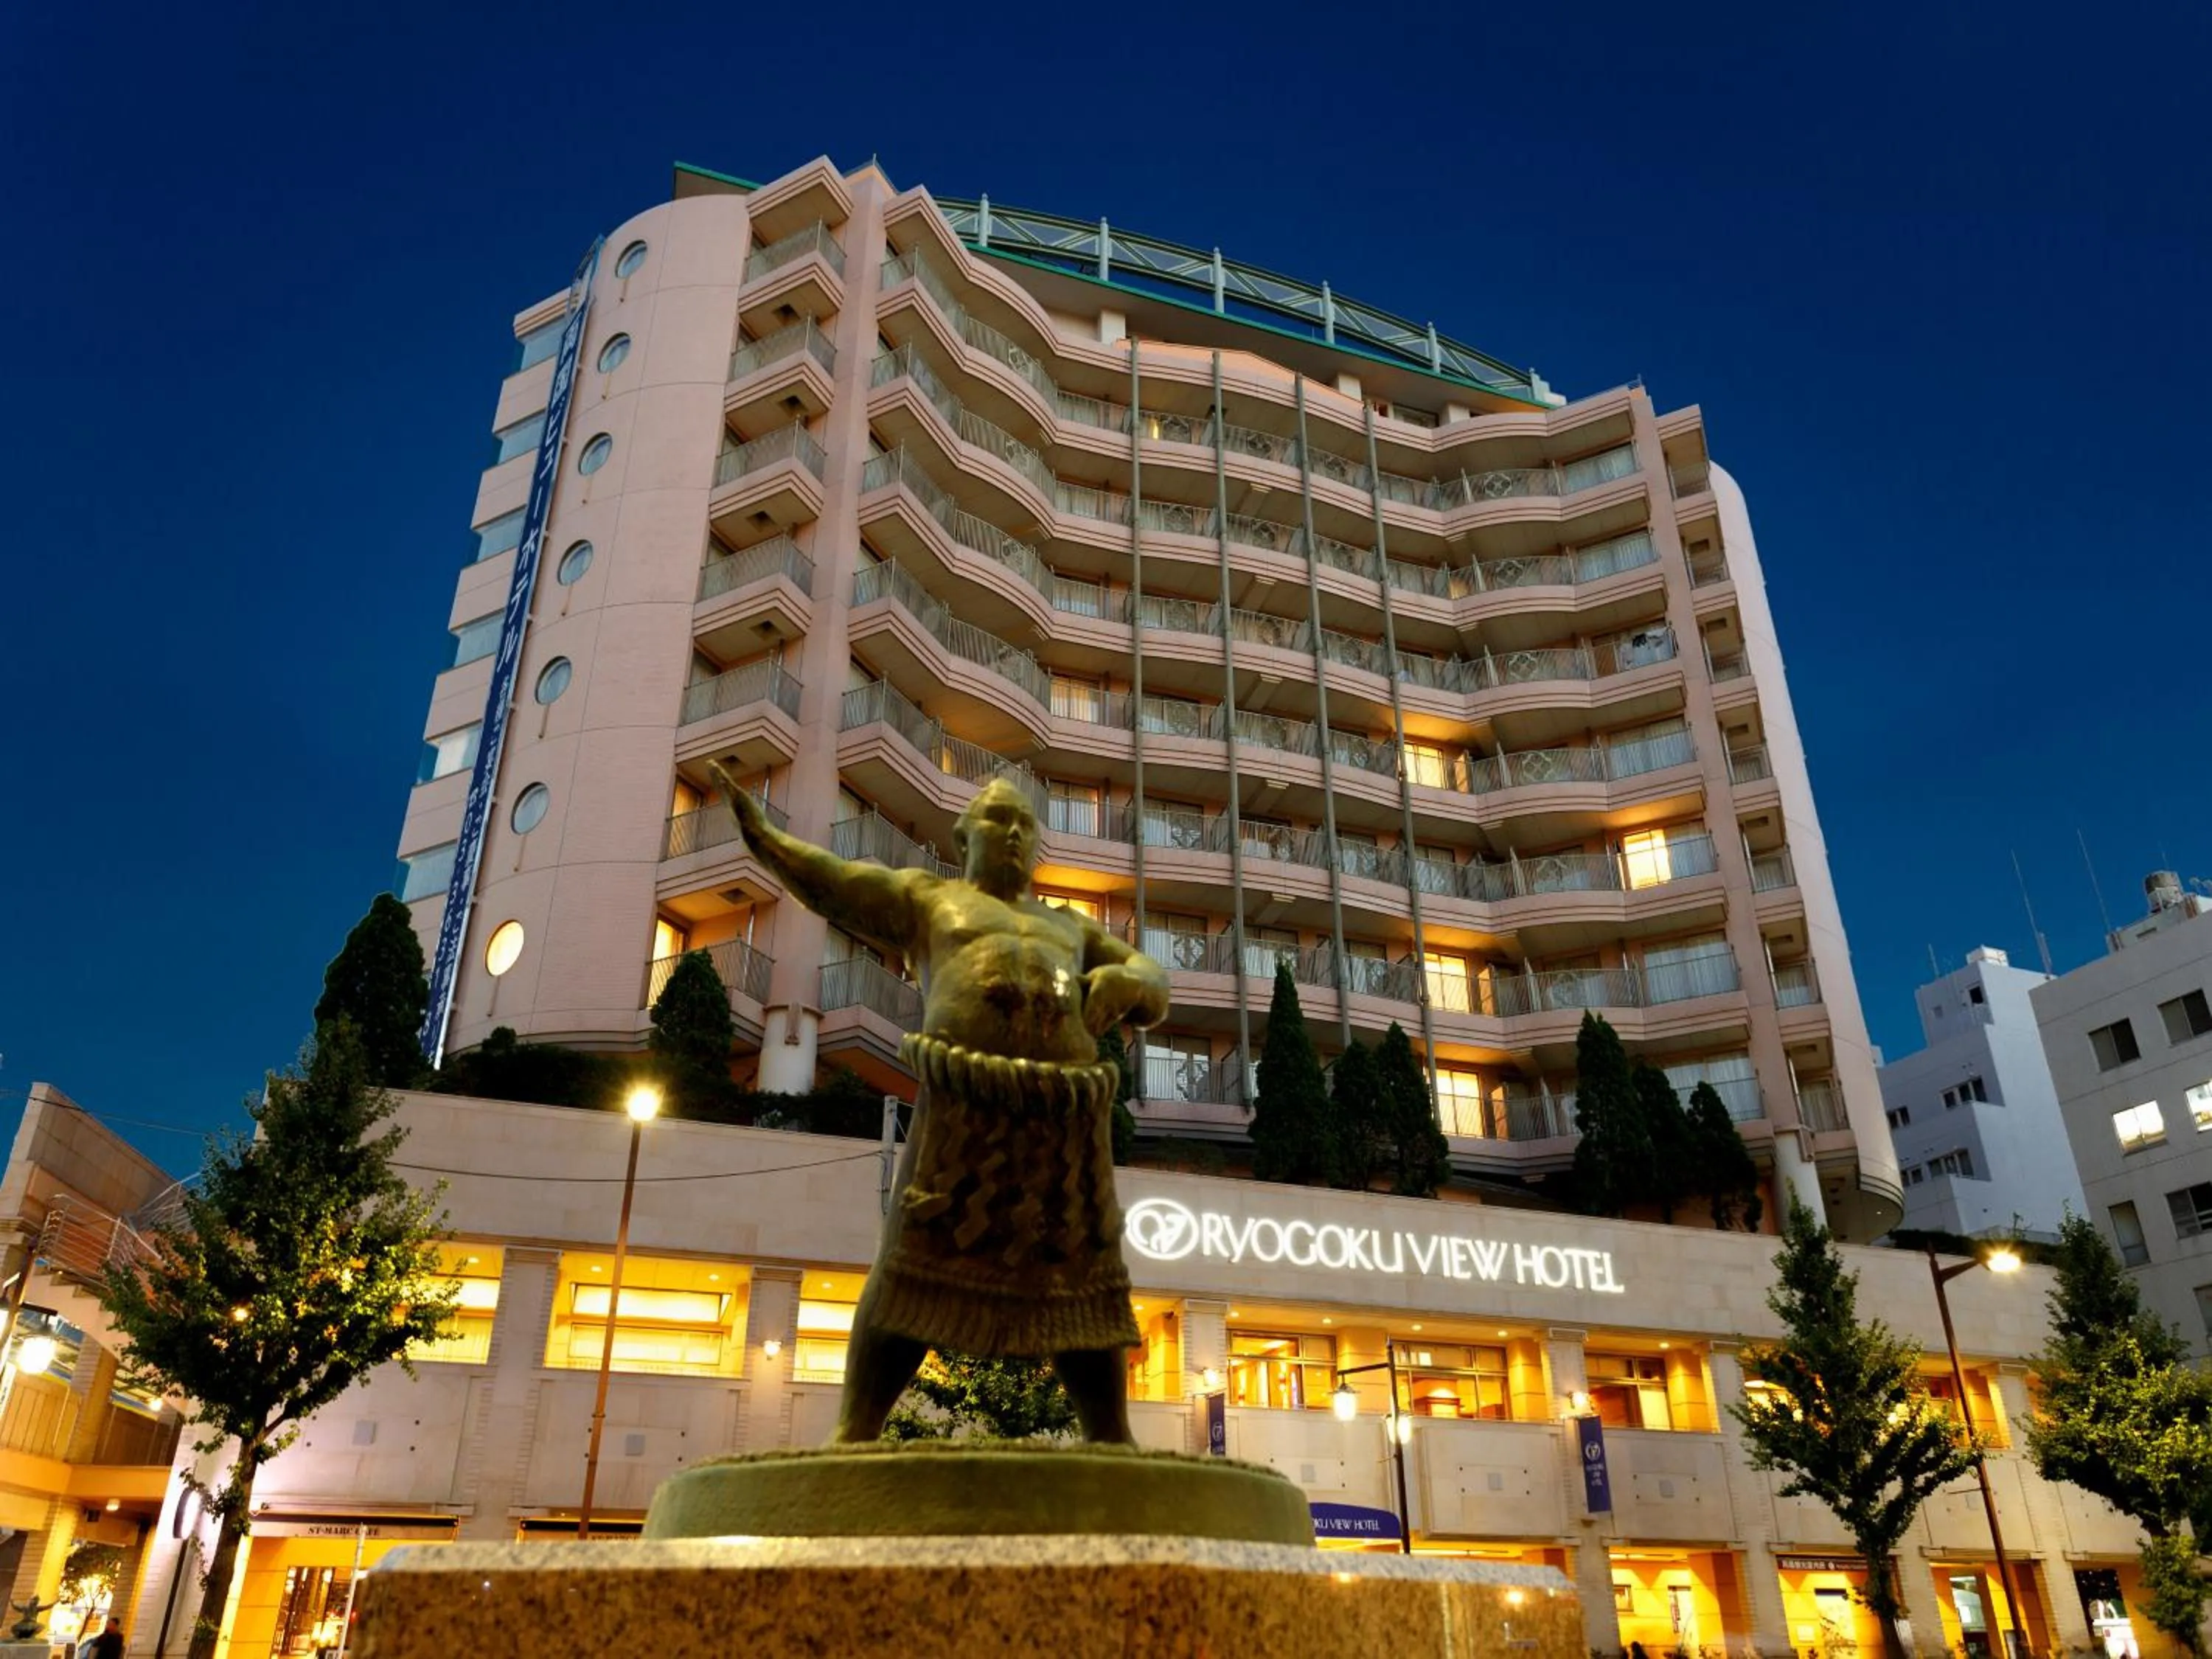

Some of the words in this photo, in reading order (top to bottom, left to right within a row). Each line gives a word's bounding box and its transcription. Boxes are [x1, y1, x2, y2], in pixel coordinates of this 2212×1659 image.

[496, 313, 582, 673] 両国ビューホテル
[1201, 1212, 1404, 1273] RYOGOKU
[1406, 1234, 1507, 1281] VIEW
[1514, 1243, 1625, 1293] HOTEL
[1329, 1518, 1351, 1530] VIEW
[1354, 1519, 1380, 1531] HOTEL
